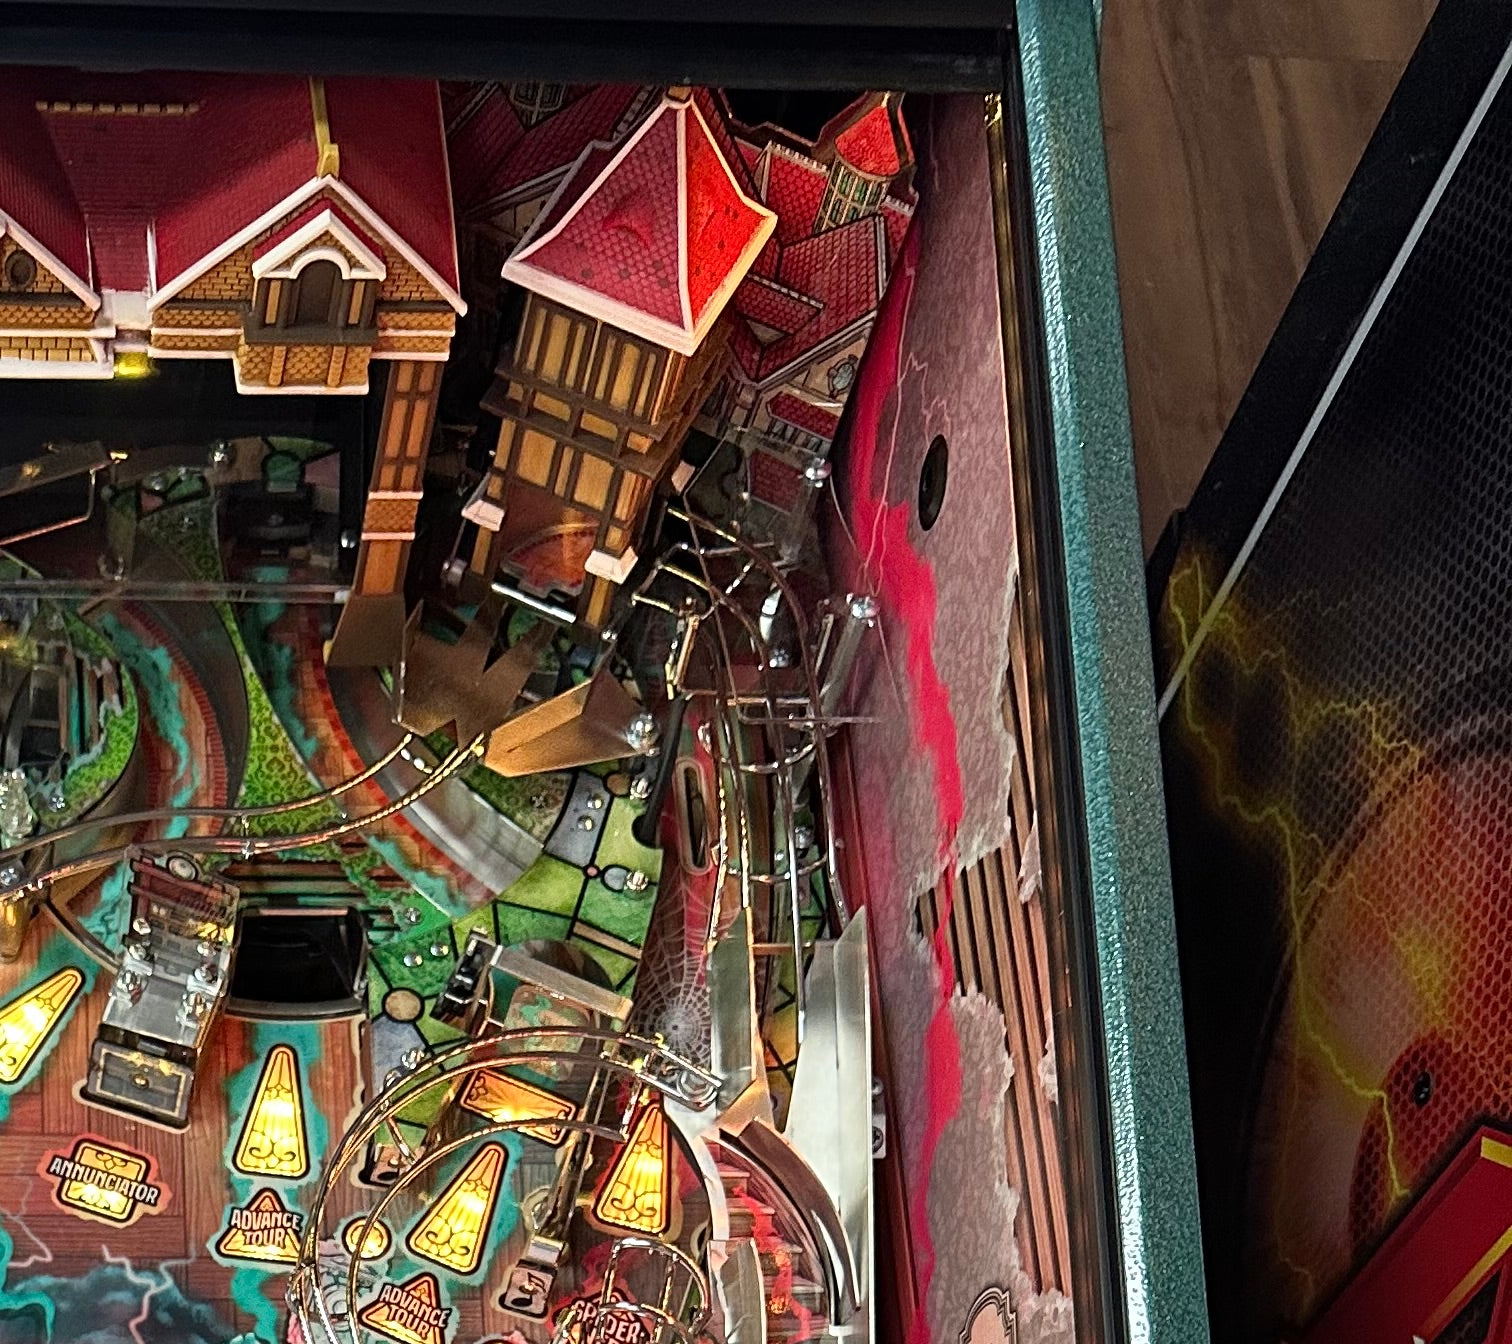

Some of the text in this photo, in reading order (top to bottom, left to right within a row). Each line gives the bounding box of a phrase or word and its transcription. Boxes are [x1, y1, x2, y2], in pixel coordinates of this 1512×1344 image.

[49, 1157, 159, 1204] ANNUNCIATOR
[230, 1209, 302, 1232] ADVANCE
[243, 1229, 288, 1248] TOUR
[379, 1284, 448, 1328] ADVANCE
[389, 1304, 430, 1338] TOUR
